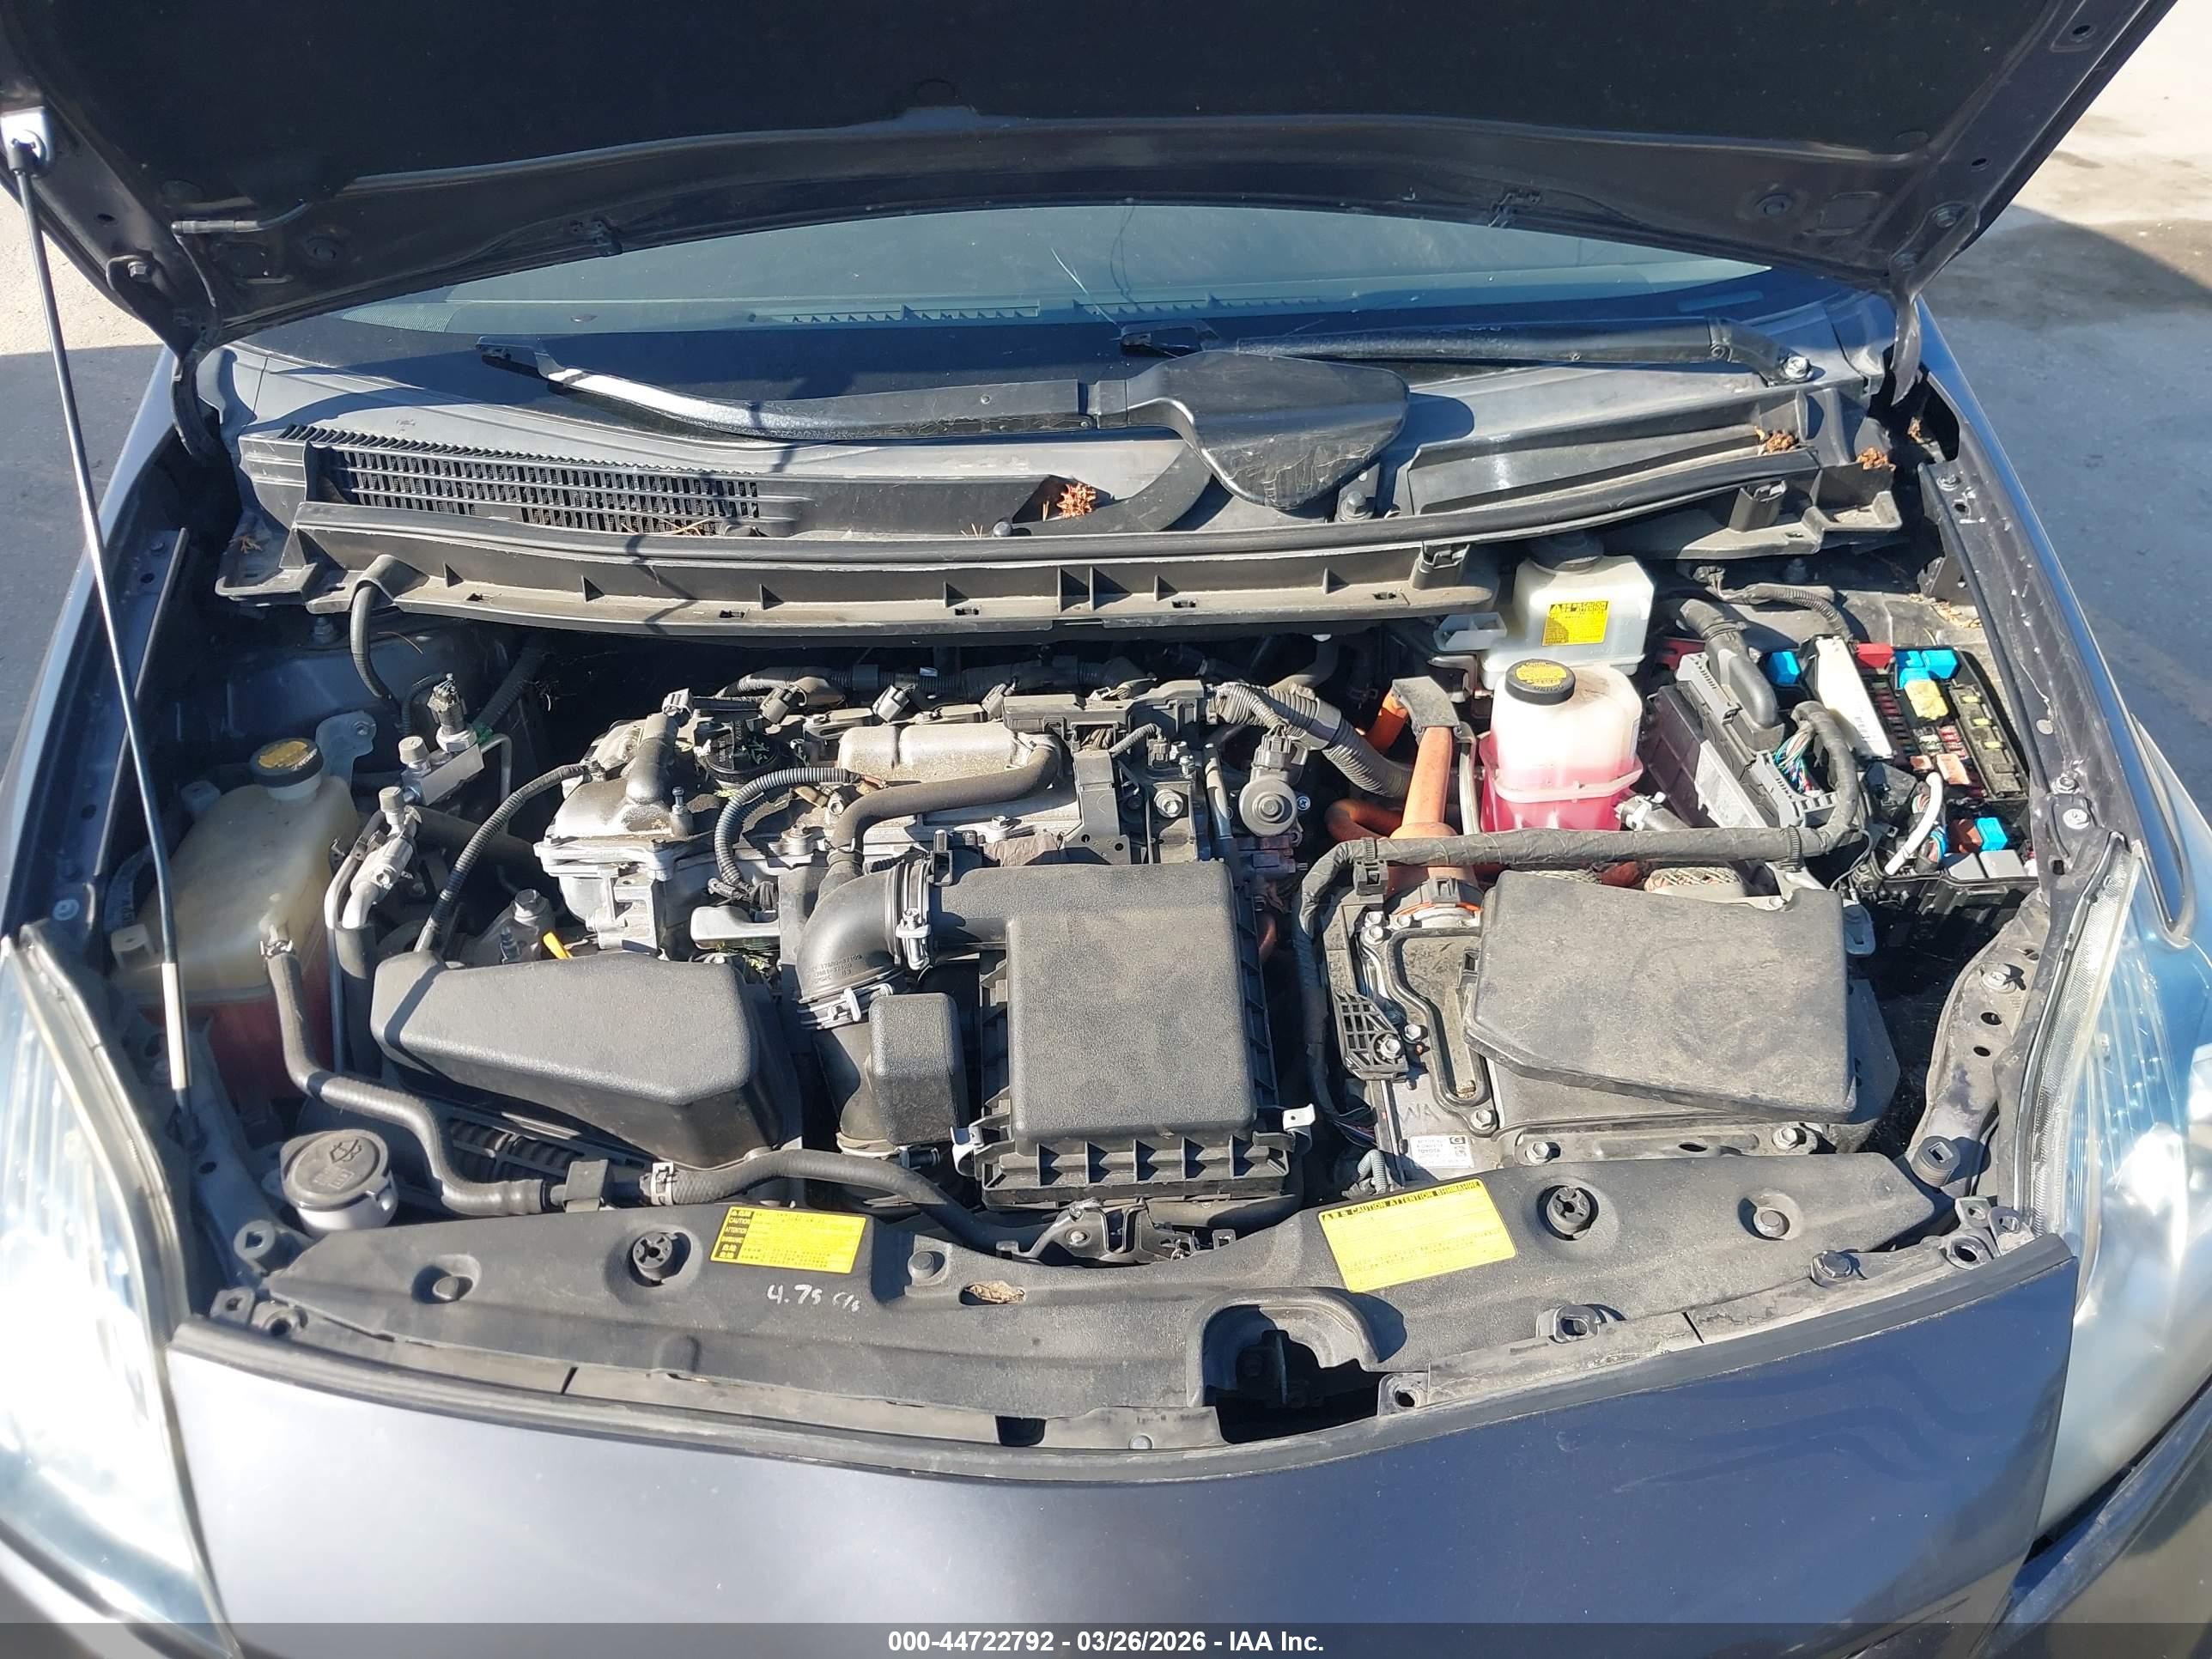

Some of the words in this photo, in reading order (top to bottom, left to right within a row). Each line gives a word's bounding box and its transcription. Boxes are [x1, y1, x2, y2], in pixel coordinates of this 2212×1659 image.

[1351, 1202, 1386, 1215] CAUTION
[1389, 1192, 1432, 1206] ATTENTION
[729, 1217, 751, 1225] CAUTION
